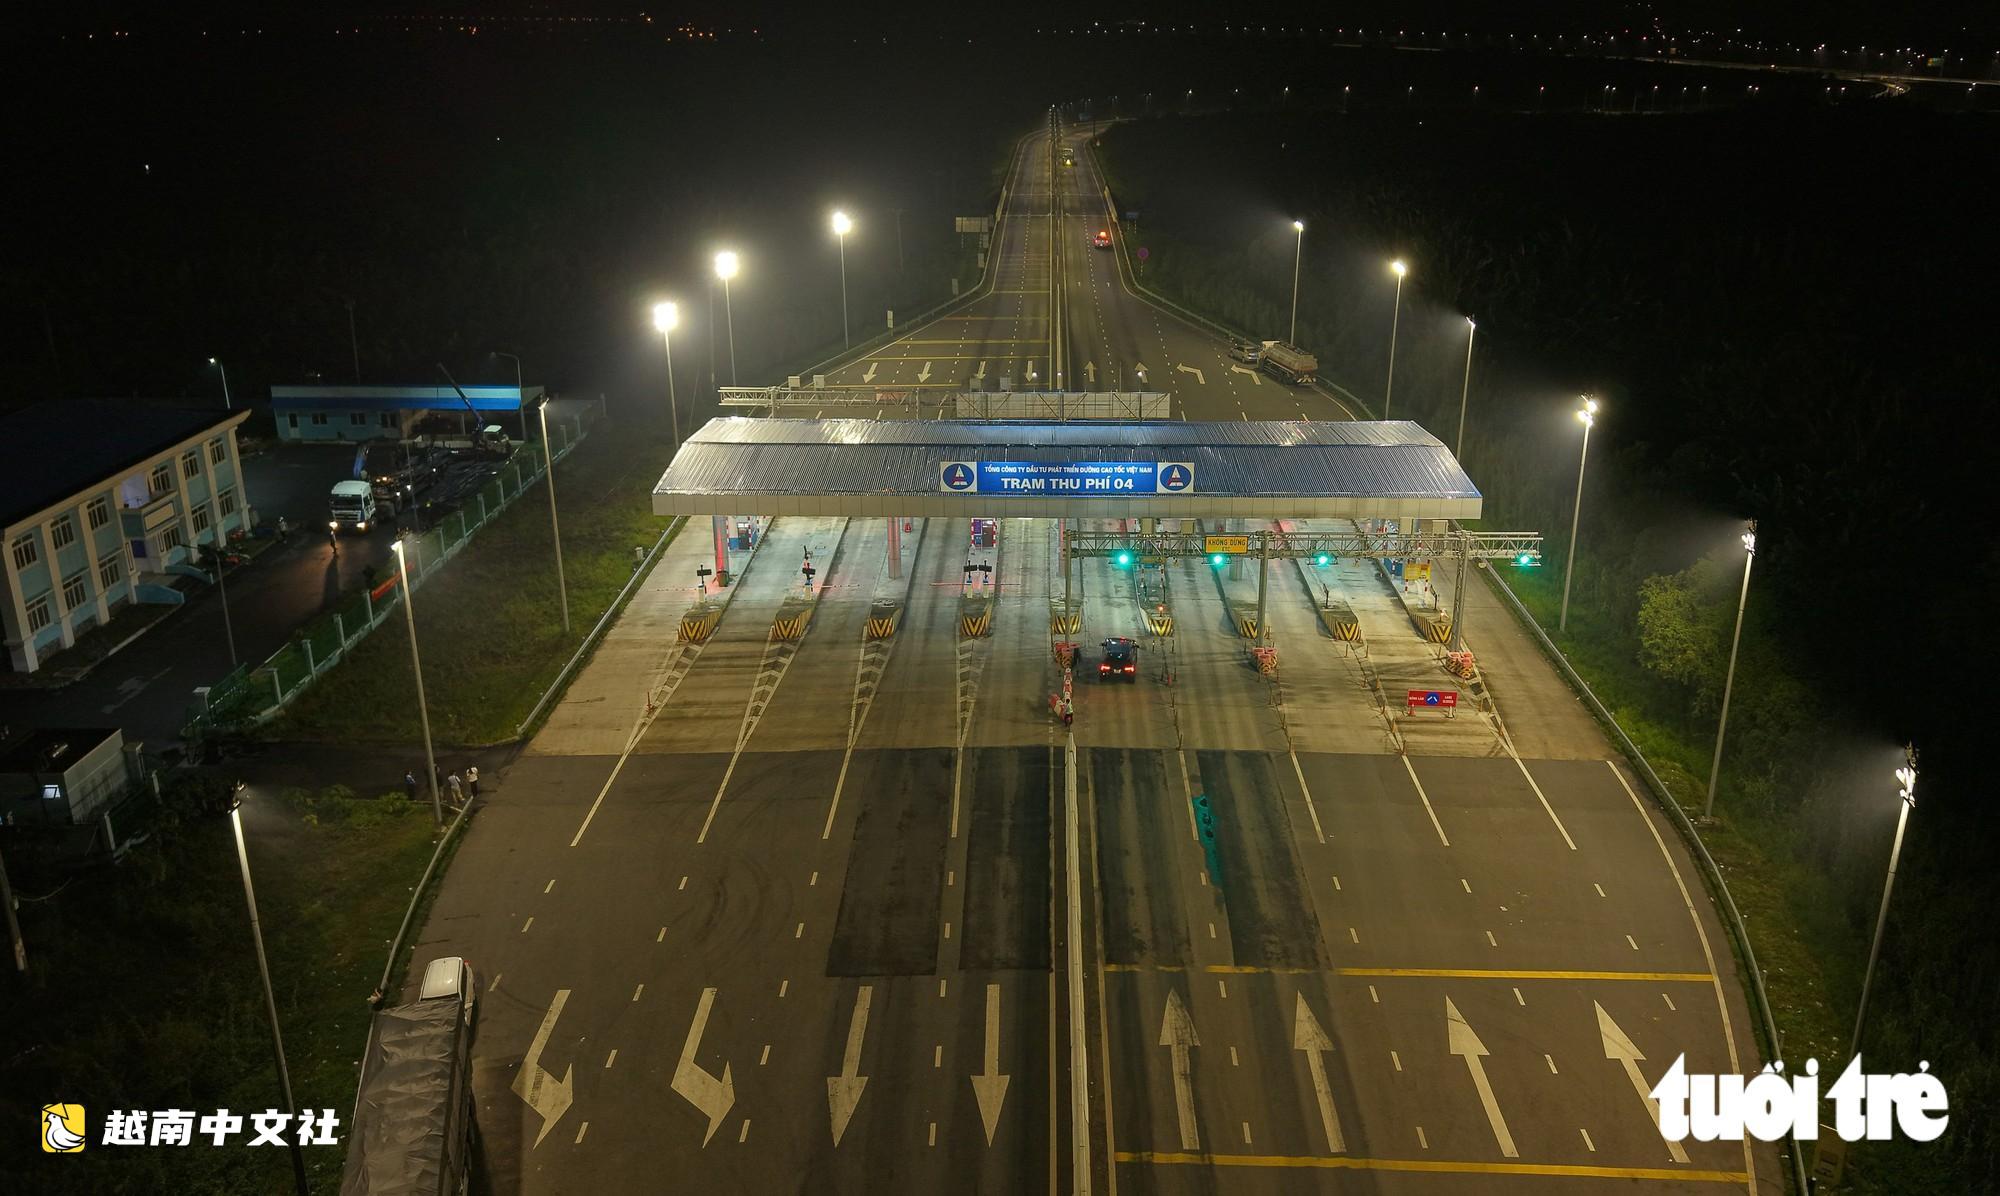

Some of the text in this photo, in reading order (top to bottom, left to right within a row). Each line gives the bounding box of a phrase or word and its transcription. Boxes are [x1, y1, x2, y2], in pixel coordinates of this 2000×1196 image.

[984, 464, 1000, 473] TỔNG
[1001, 465, 1017, 473] CÔNG
[1048, 465, 1062, 473] PHÁT
[1114, 465, 1125, 473] TỐC
[1126, 466, 1138, 474] VIỆT
[1001, 476, 1134, 492] TRẠM THU PHÍ 04
